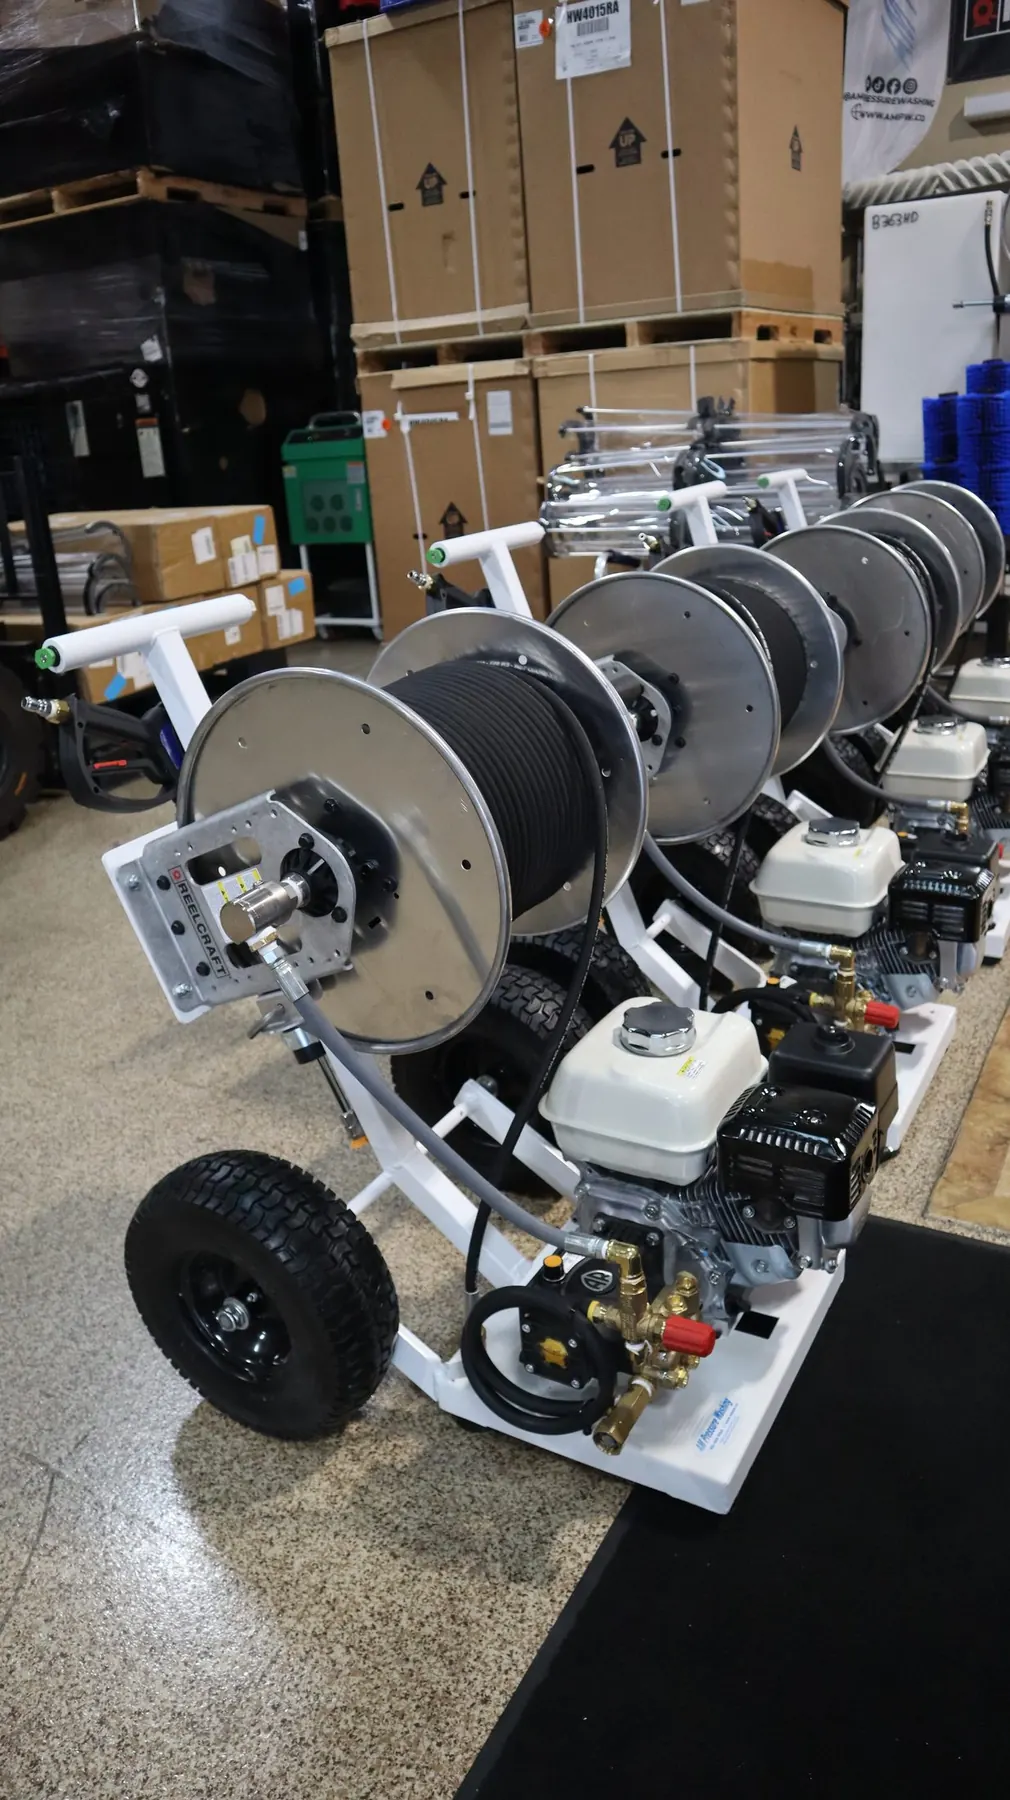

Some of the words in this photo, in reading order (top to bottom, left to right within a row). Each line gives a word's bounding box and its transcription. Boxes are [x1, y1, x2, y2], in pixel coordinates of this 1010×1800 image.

[566, 1, 620, 24] HW4015RA
[619, 133, 637, 148] UP
[178, 882, 227, 976] REELCRAFT
[700, 1417, 719, 1443] Pressure
[713, 1397, 733, 1421] Washing
